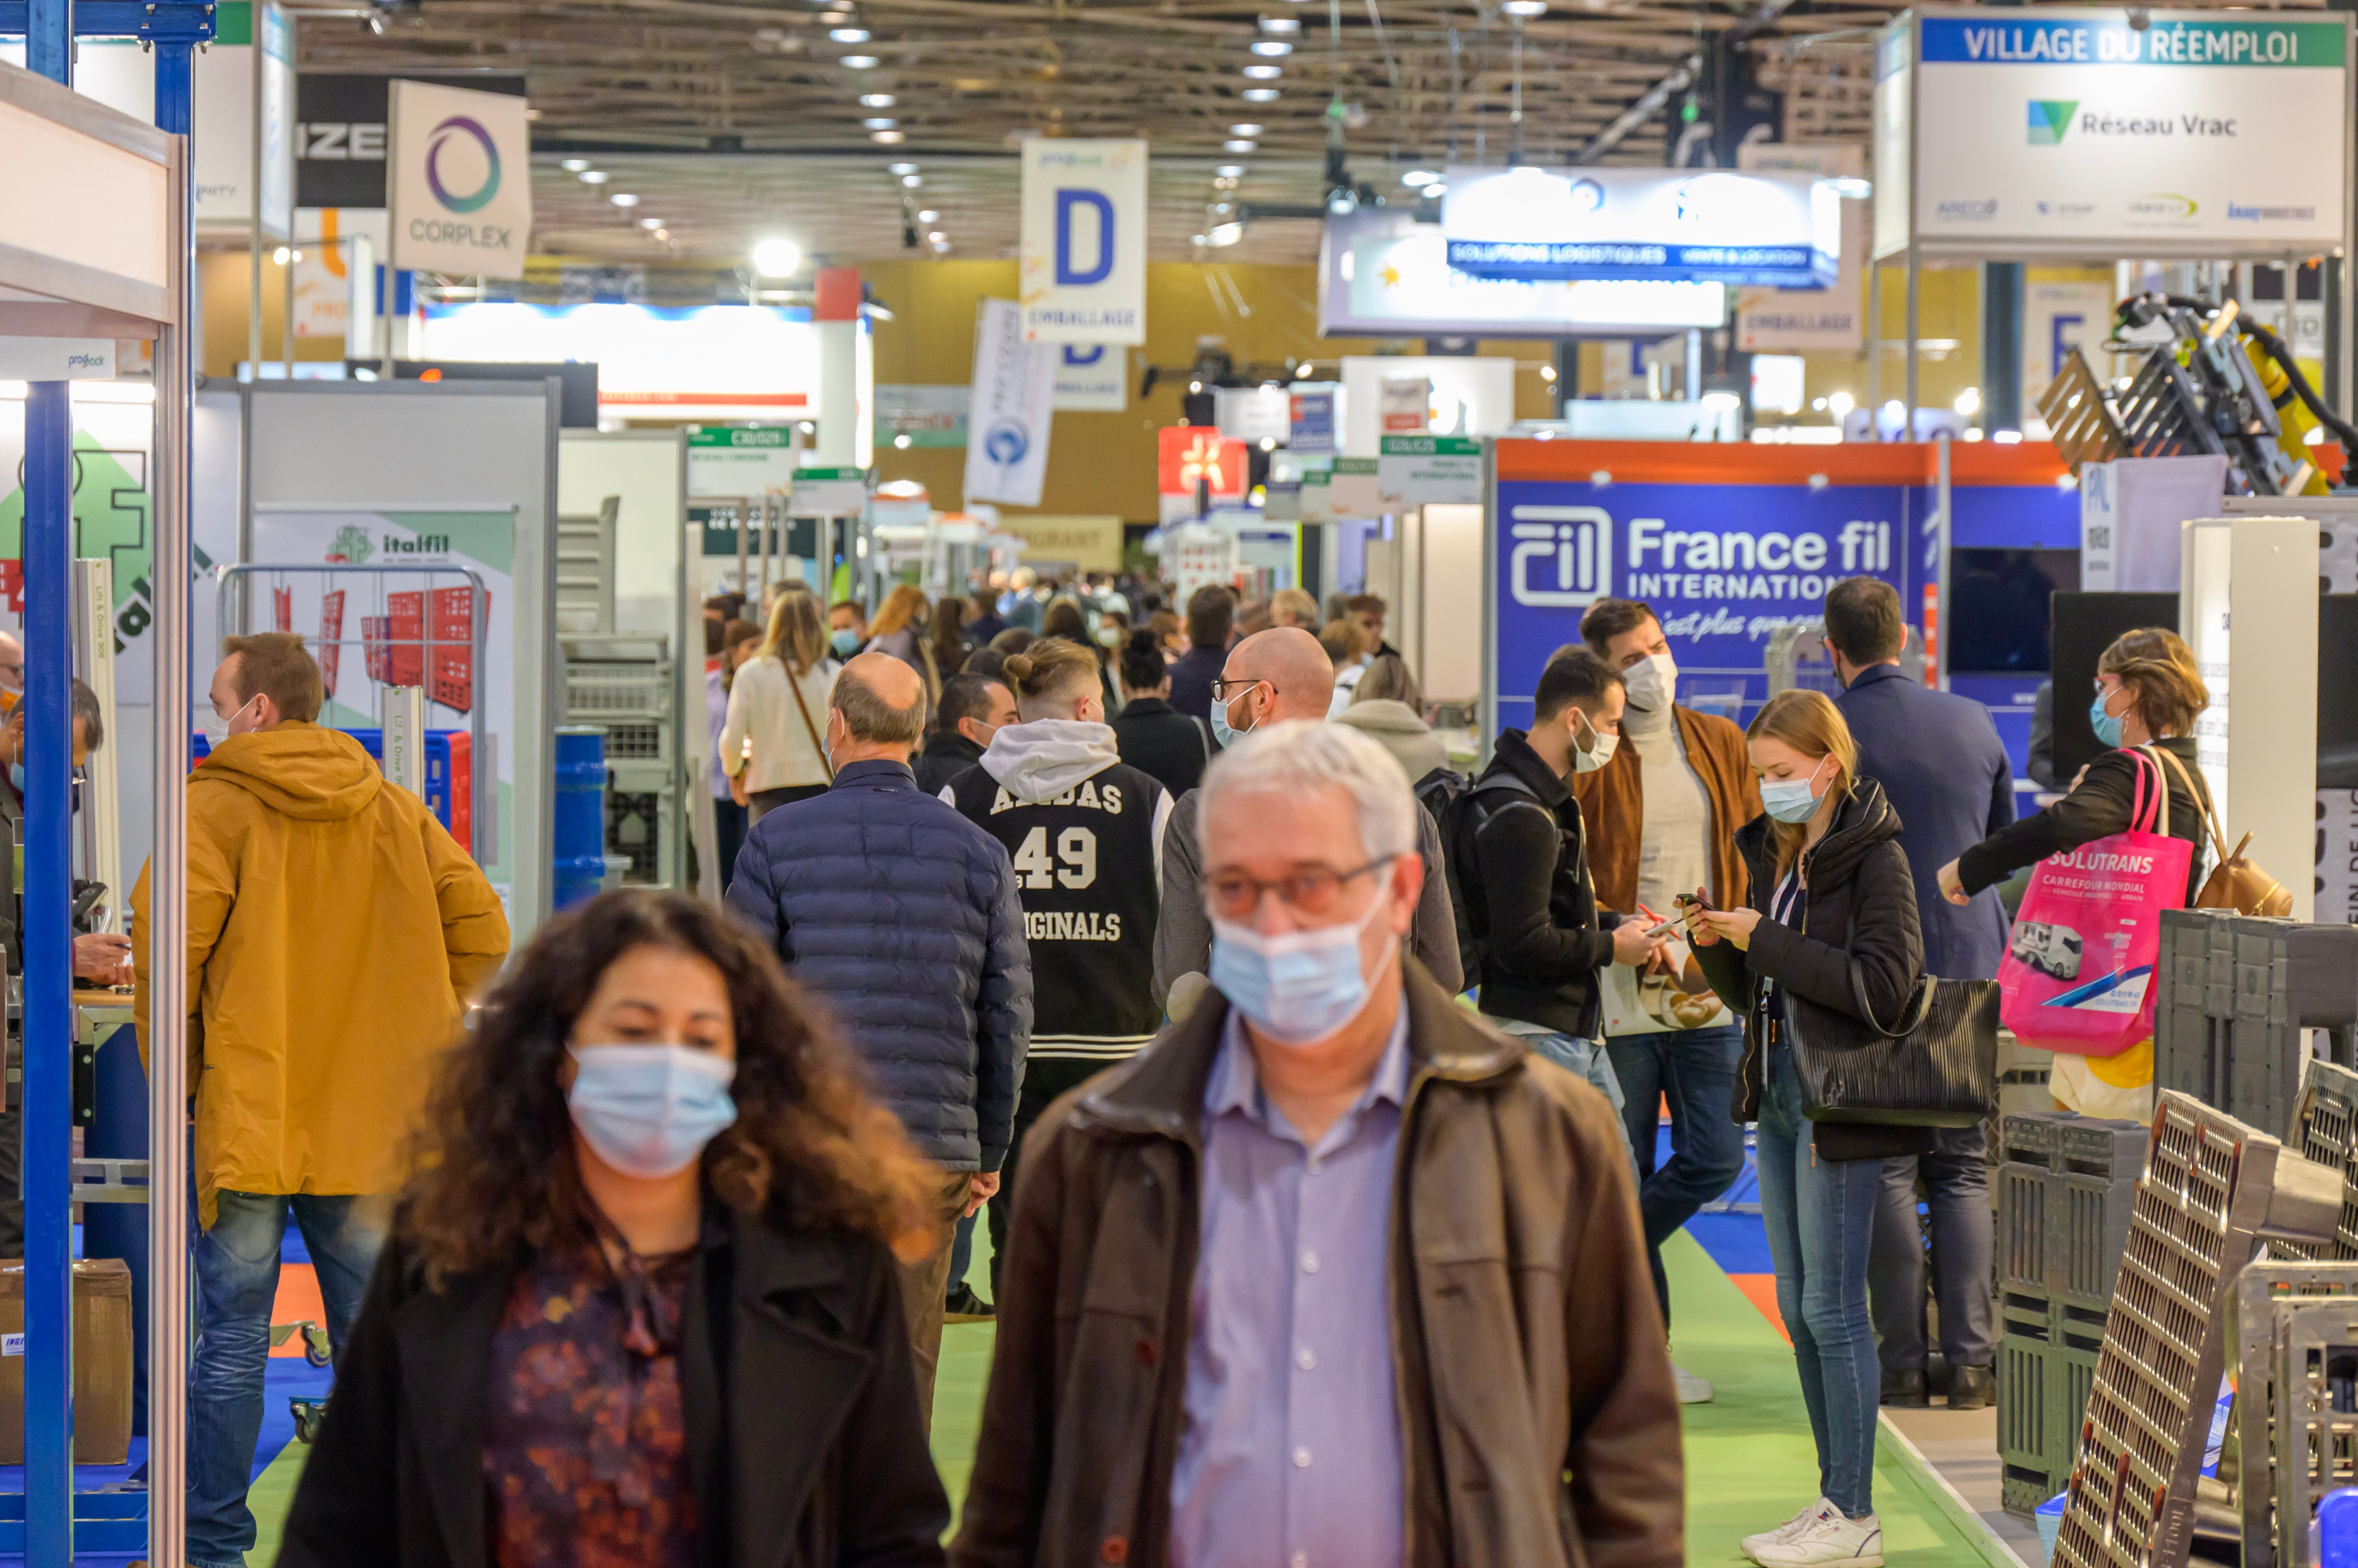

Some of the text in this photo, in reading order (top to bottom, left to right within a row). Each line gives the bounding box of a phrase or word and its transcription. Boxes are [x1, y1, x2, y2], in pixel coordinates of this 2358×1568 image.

[1964, 22, 2299, 62] VILLAGE DU RÉEMPLOI
[2082, 112, 2237, 137] Réseau Vrac
[409, 218, 512, 250] CORPLEX
[1056, 188, 1115, 285] D
[383, 533, 449, 553] italfil
[1628, 518, 1891, 571] France fil
[1628, 572, 1837, 600] INTERNATIO
[394, 746, 402, 772] Drive
[990, 780, 1122, 815] ADAS
[1014, 826, 1097, 889] 49
[2048, 851, 2154, 874] SOLUTRANS
[2044, 875, 2145, 894] CARREFOUR MONDIAL
